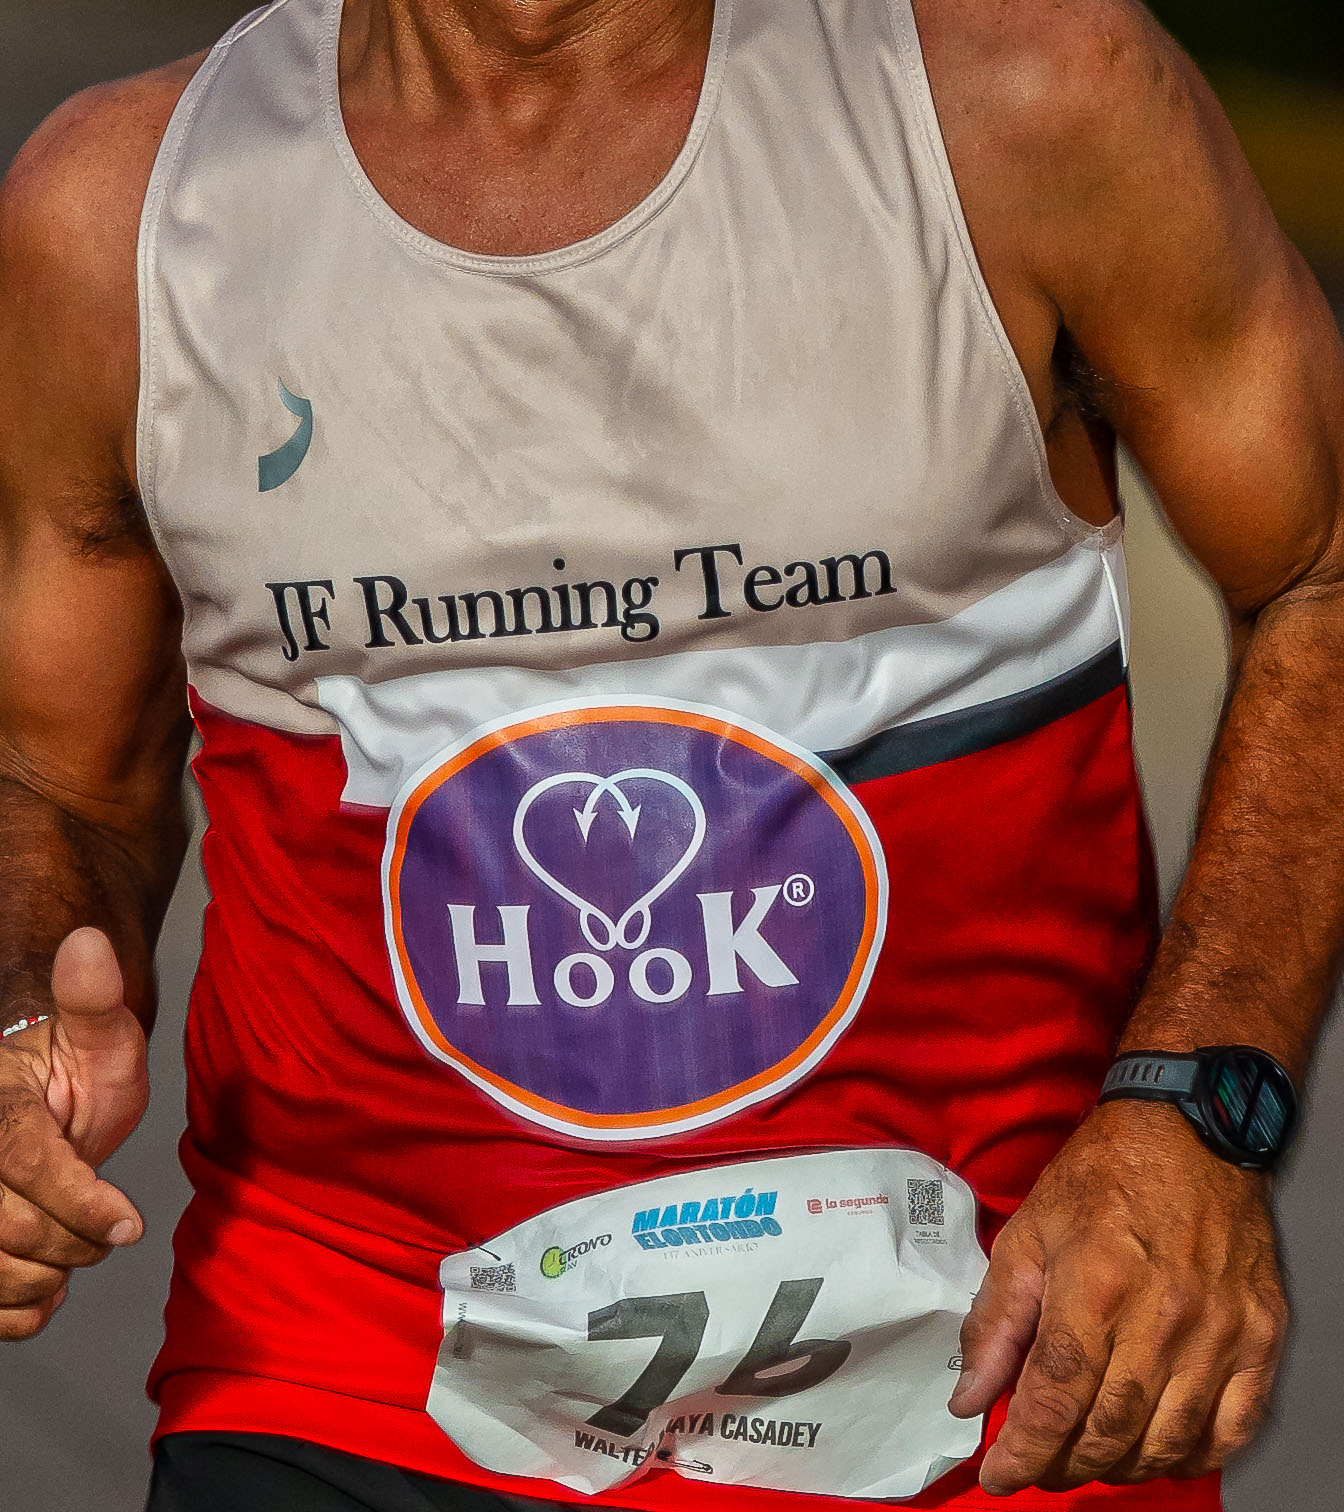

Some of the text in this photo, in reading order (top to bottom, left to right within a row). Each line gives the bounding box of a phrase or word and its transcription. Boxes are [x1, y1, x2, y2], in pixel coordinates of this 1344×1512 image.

[264, 543, 898, 663] JF Running Team
[632, 1187, 778, 1234] MARATÓN
[559, 1233, 612, 1265] CRONO
[633, 1216, 783, 1251] ELORTONDO
[587, 1277, 852, 1437] 76
[720, 1414, 822, 1447] CASADEY
